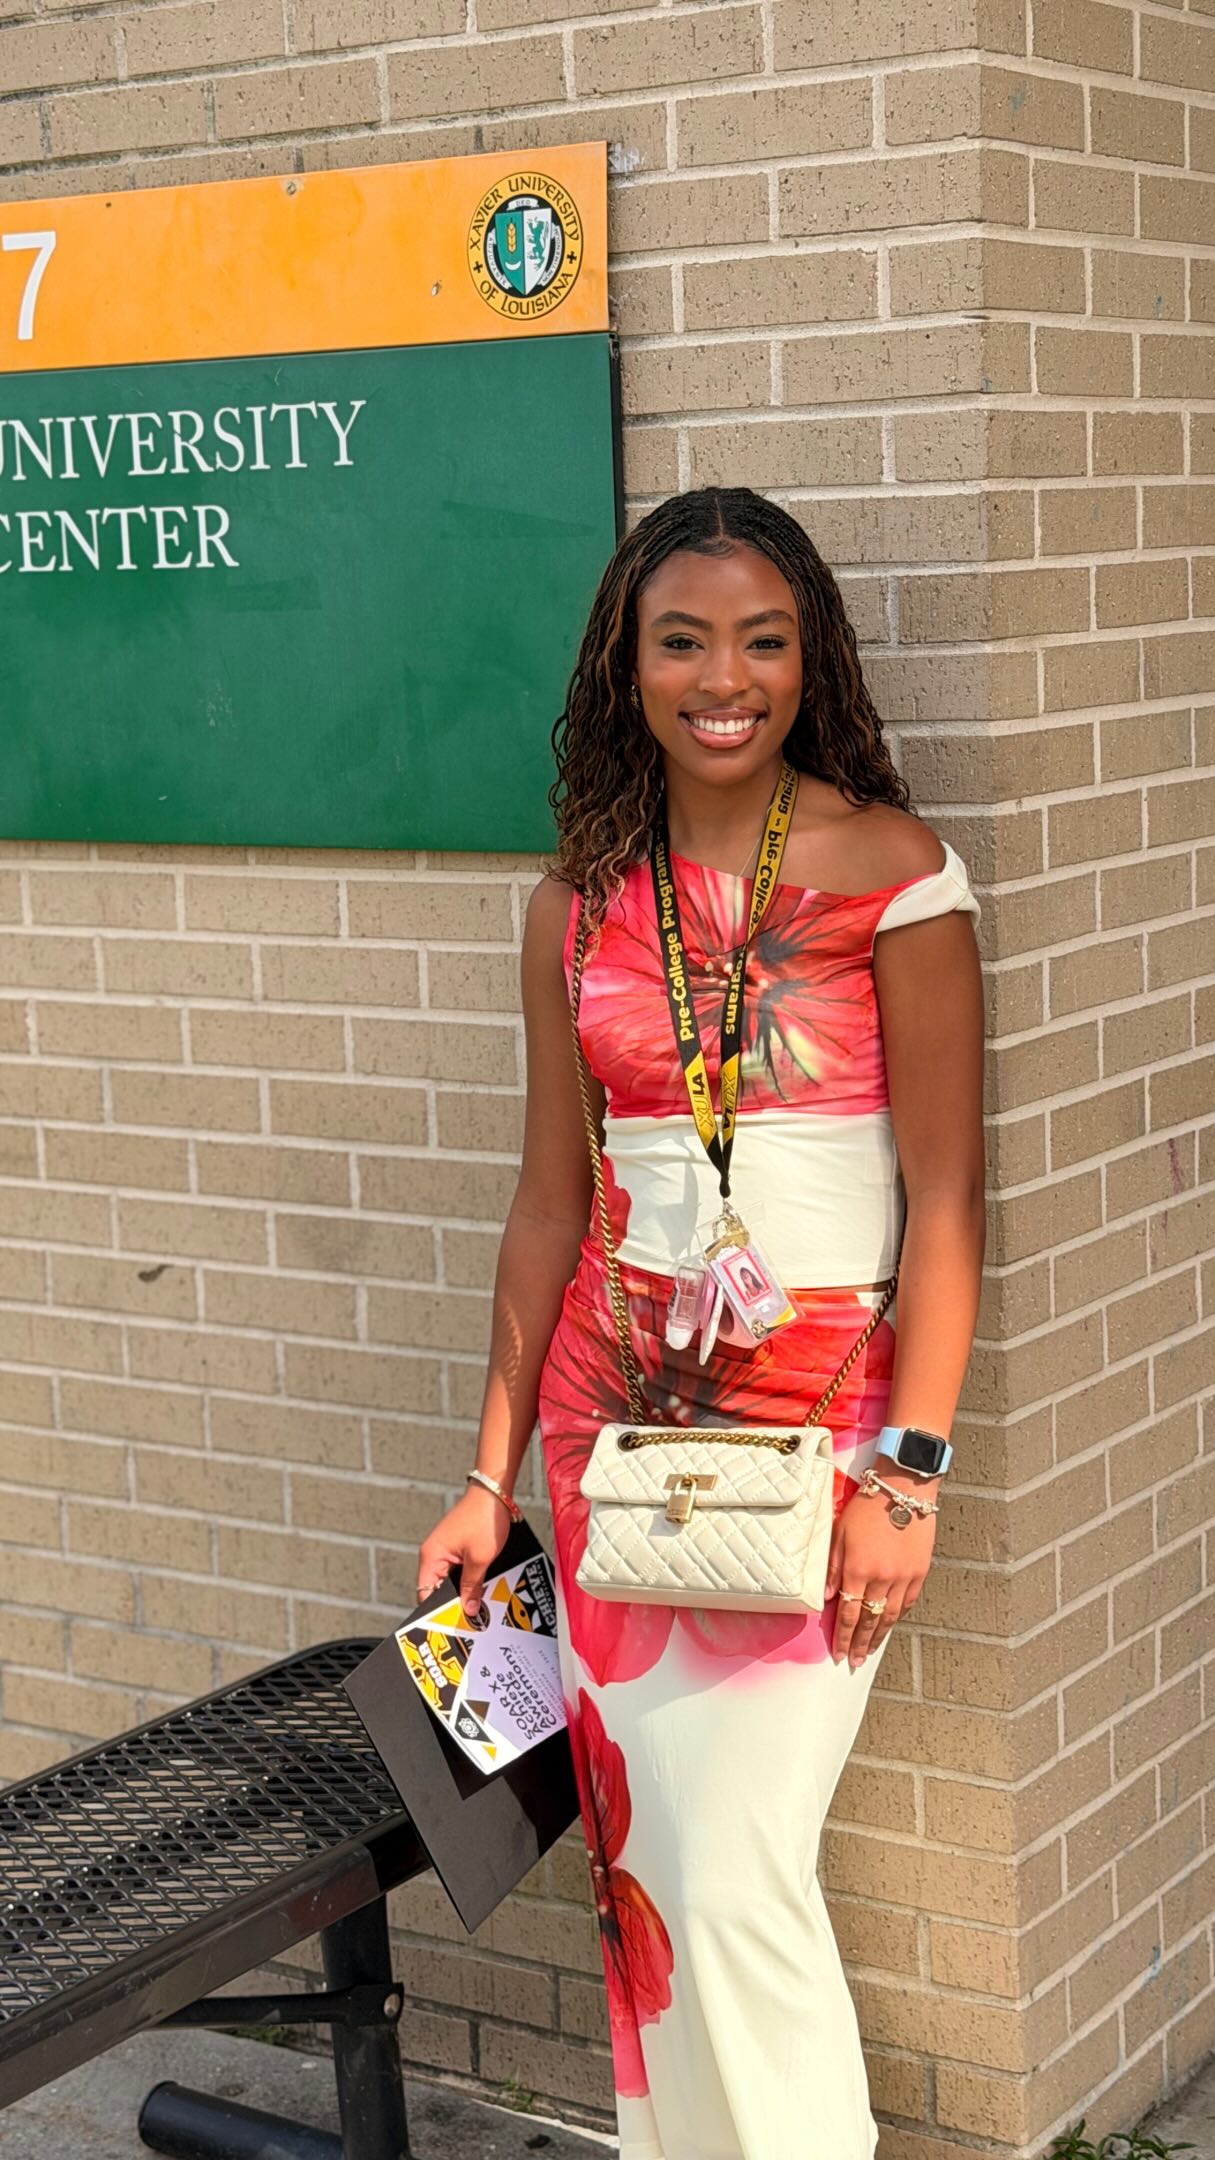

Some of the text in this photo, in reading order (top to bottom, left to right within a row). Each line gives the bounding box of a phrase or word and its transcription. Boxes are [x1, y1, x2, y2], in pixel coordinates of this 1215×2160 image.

[470, 176, 580, 251] XAVIER UNIVERSITY
[2, 230, 57, 341] 7
[480, 272, 573, 316] OF LOUISIANA
[0, 400, 367, 482] NIVERSITY
[655, 841, 695, 1042] Pre-College Programs
[724, 949, 746, 1035] rograms
[689, 1071, 715, 1129] XULA
[721, 1073, 736, 1131] XULA
[418, 1641, 448, 1689] SOAR
[498, 1644, 558, 1726] Ceremony
[505, 1670, 550, 1731] Awards
[479, 1665, 534, 1741] SOAR X &
[495, 1671, 543, 1737] Achieve
